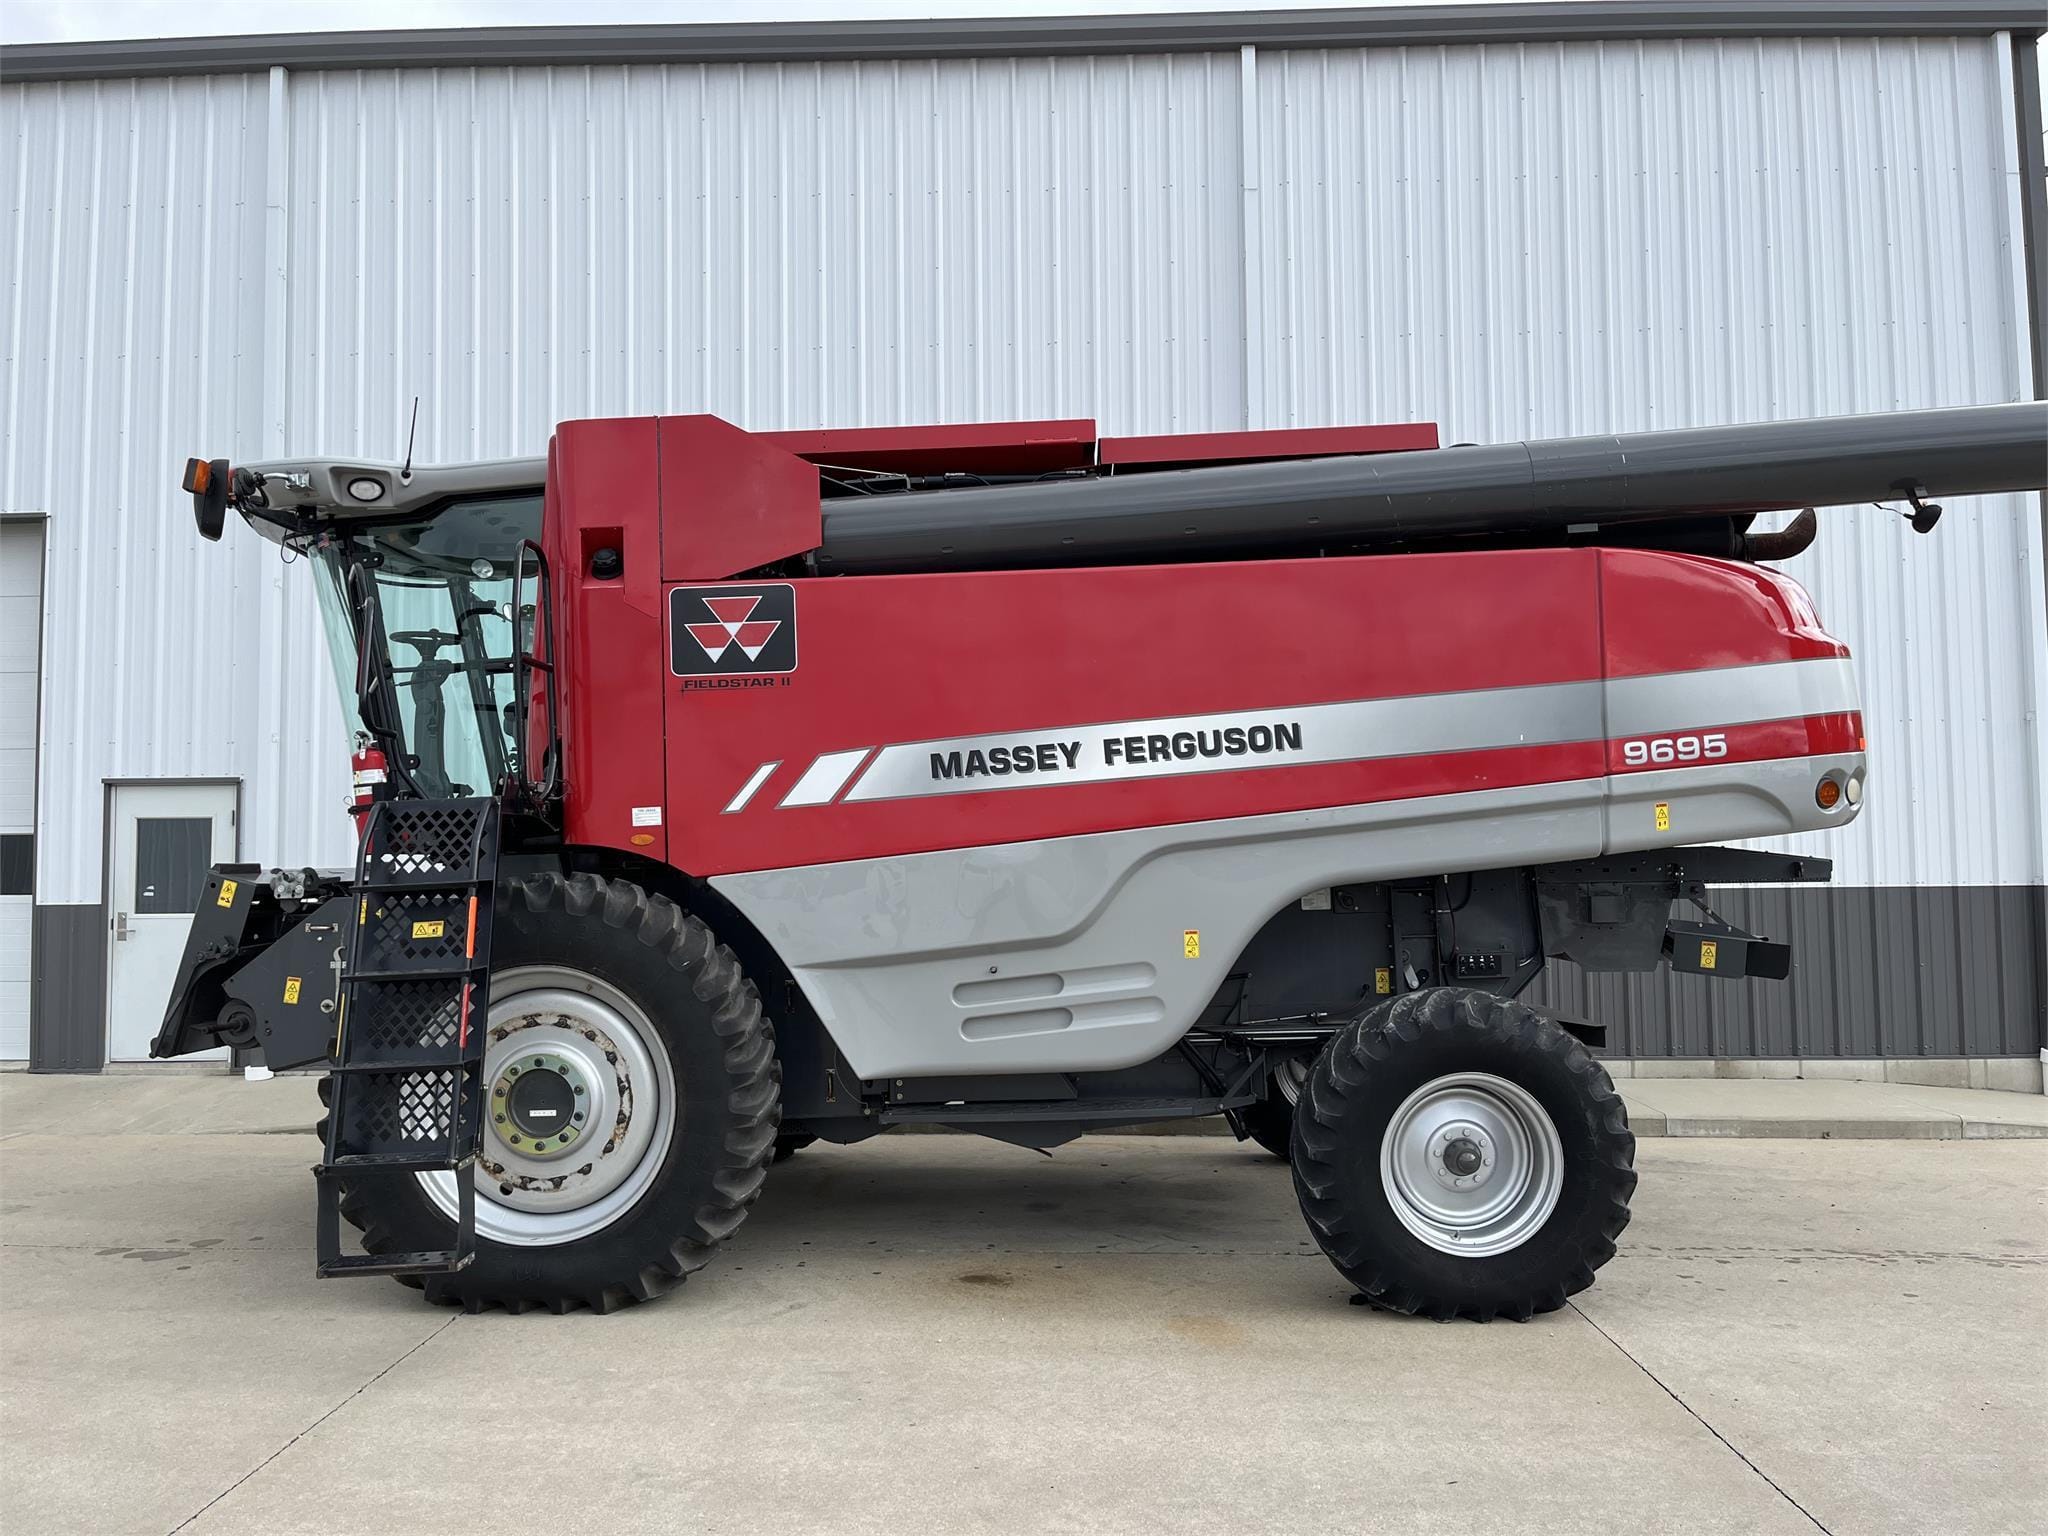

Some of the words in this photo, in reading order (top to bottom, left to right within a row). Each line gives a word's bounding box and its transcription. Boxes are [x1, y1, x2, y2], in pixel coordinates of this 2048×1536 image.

[684, 678, 775, 689] FIELDSTAR
[781, 677, 790, 686] II
[930, 741, 1083, 780] MASSEY
[1103, 722, 1303, 767] FERGUSON
[1623, 733, 1728, 766] 9695
